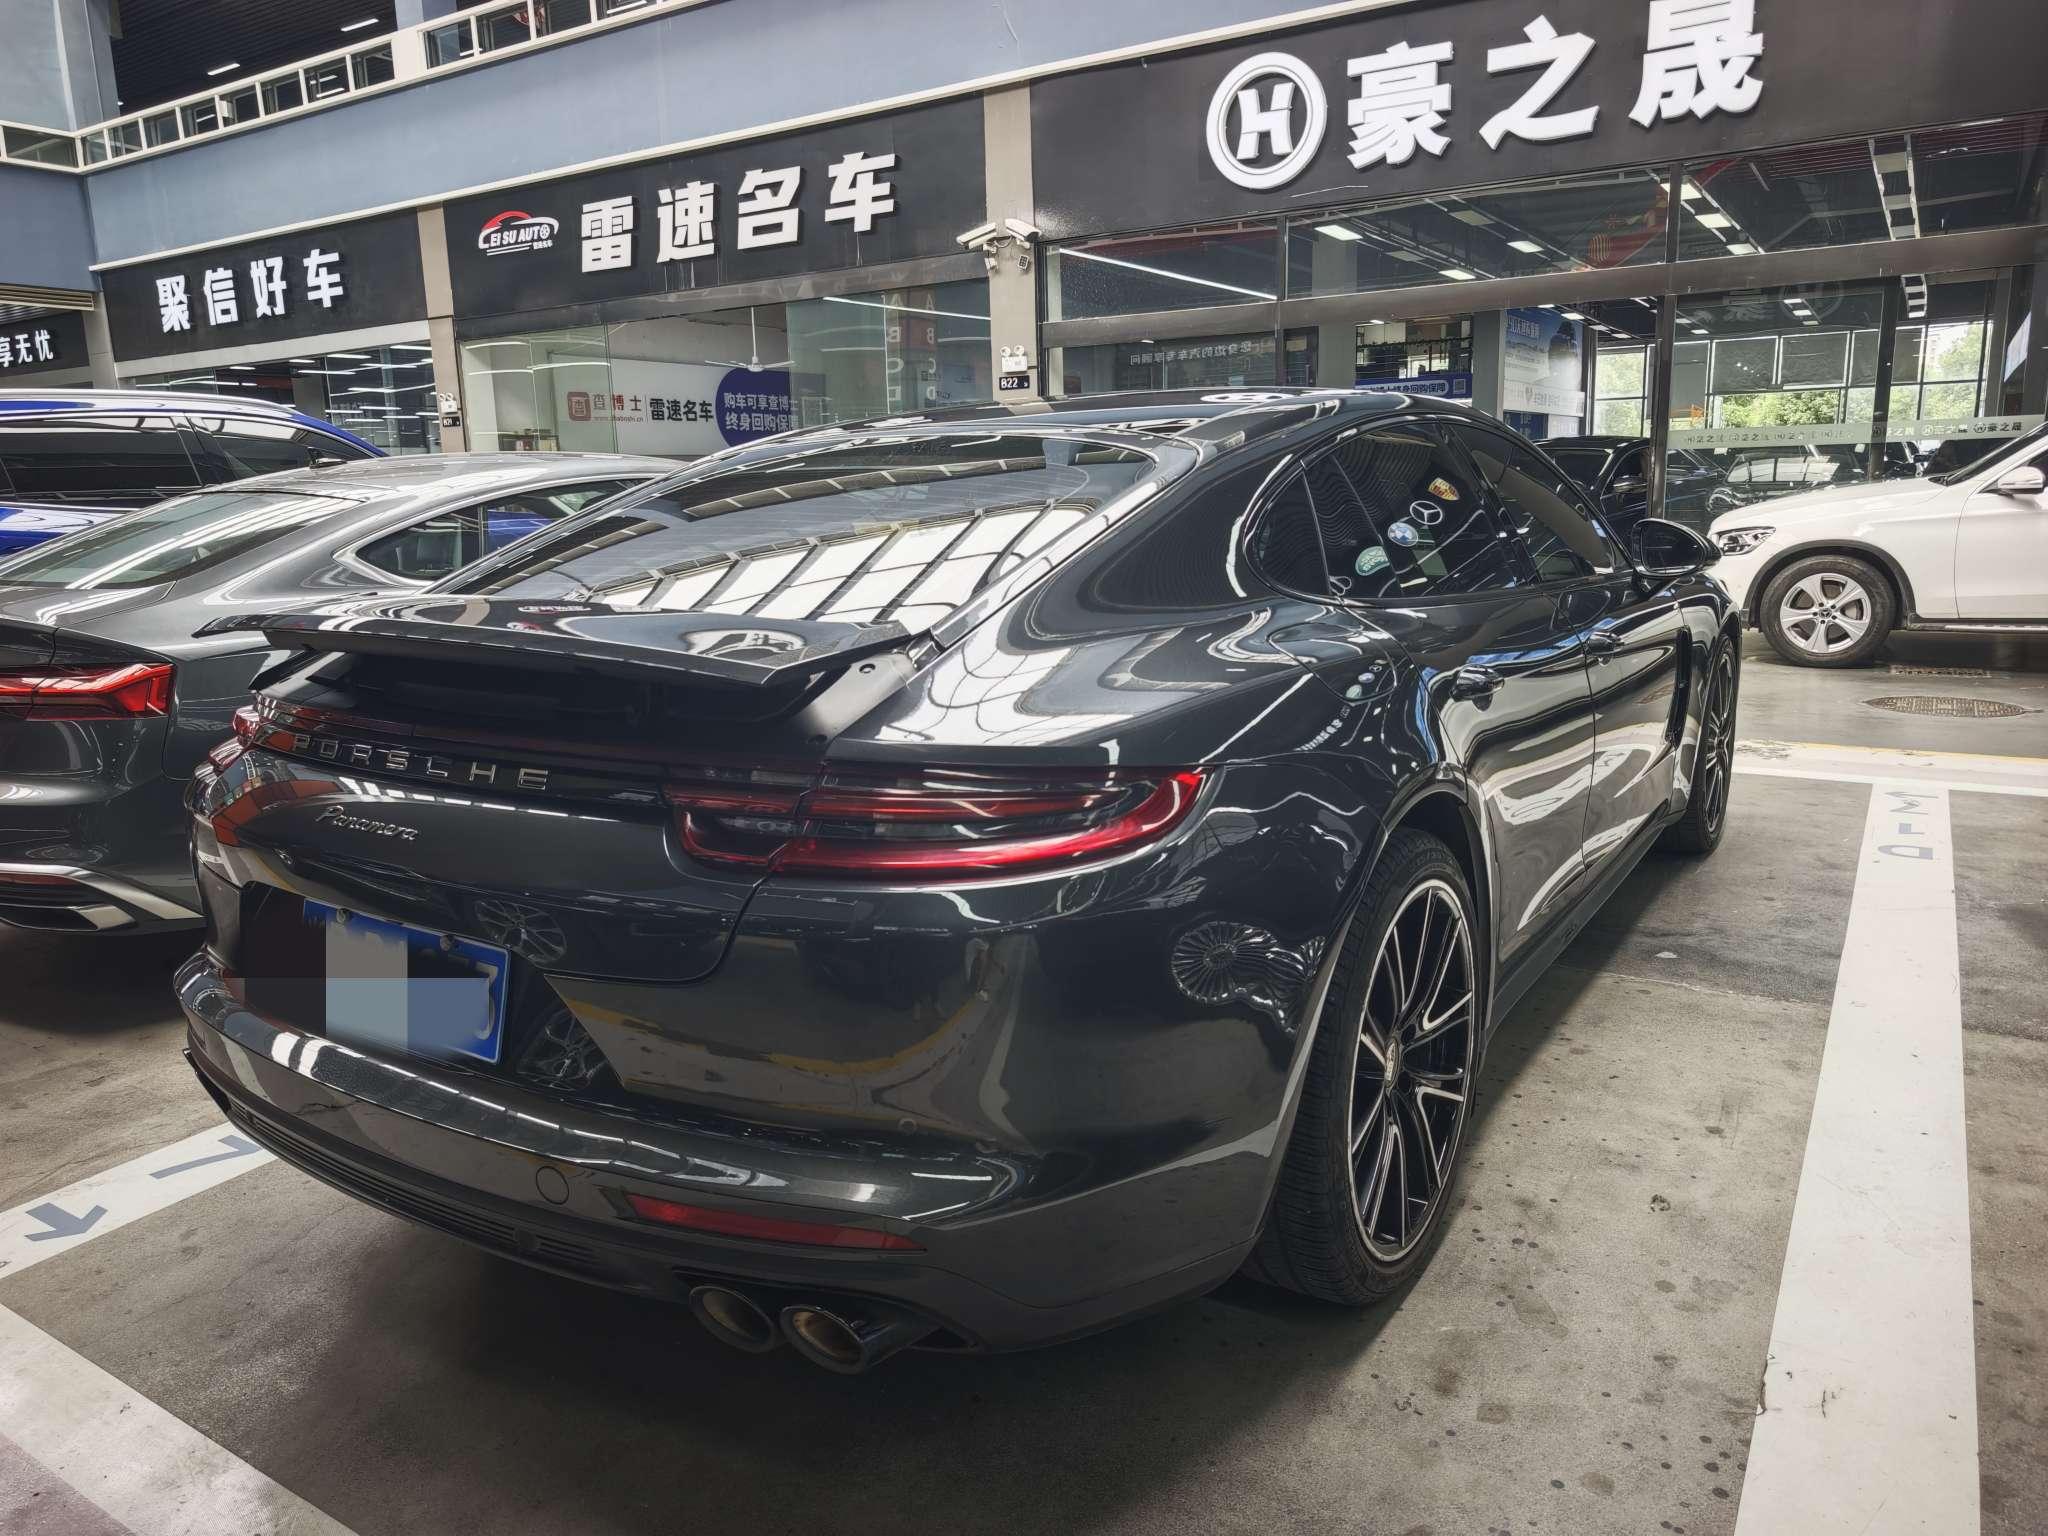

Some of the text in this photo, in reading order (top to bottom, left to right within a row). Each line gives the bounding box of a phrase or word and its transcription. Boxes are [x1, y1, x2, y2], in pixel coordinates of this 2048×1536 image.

[1346, 0, 1765, 170] 豪之晟
[580, 151, 897, 273] 雷速名车
[502, 230, 517, 245] SU
[156, 249, 345, 334] 聚信好车
[593, 394, 642, 411] 查博士
[649, 398, 714, 423] 雷速名车
[723, 392, 799, 412] 购车可享查博士
[725, 412, 799, 432] 终身回购保障
[293, 734, 548, 790] PORSCHE
[314, 804, 419, 840] Panamera
